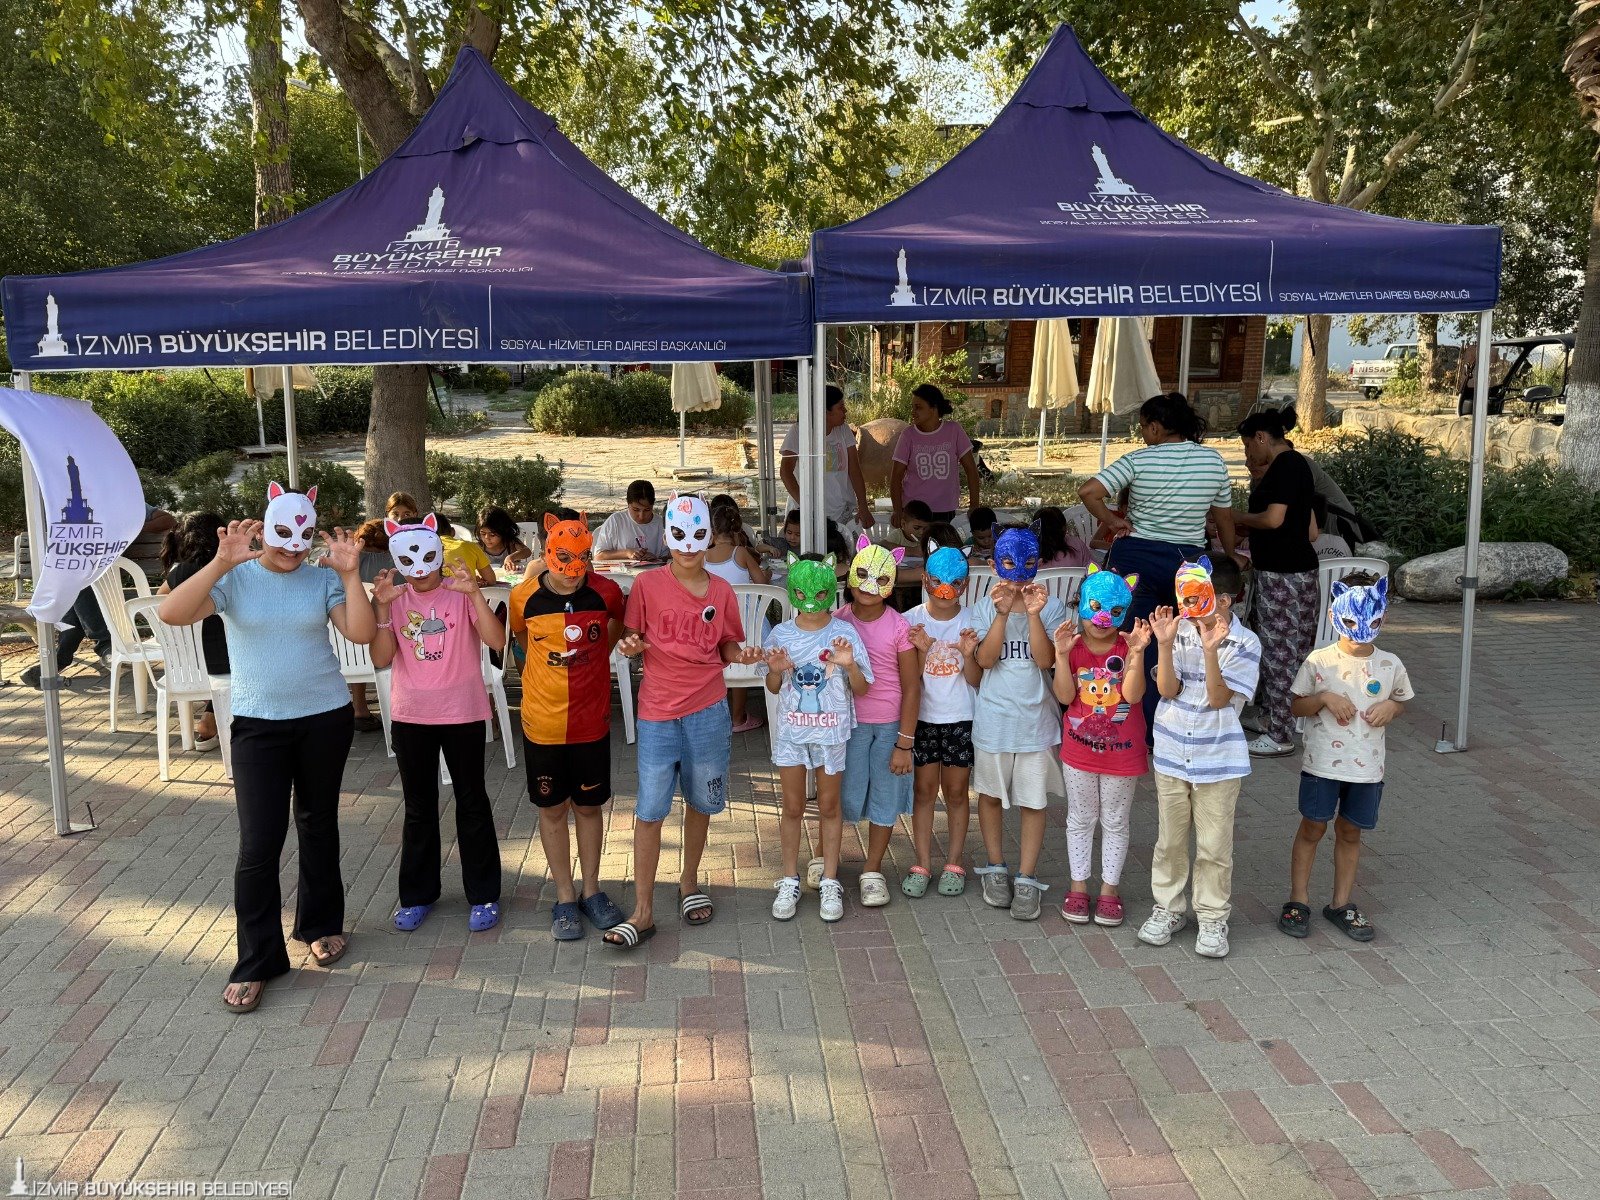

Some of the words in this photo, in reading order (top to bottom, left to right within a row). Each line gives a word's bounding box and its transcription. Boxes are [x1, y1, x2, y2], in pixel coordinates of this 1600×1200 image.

[923, 285, 986, 307] İZMİR
[993, 283, 1134, 307] BÜYÜKŞEHİR
[1140, 281, 1261, 303] BELEDİYESİ
[1279, 291, 1318, 302] SOSYAL
[1319, 290, 1374, 301] HİZMETLER
[1374, 289, 1412, 301] DAİRESİ
[1413, 289, 1471, 301] BAŞKANLIĞI
[75, 332, 153, 356] İZMİR
[160, 329, 327, 355] BÜYÜKŞEHİR
[334, 326, 480, 352] BELEDİYESİ
[500, 338, 546, 351] SOSYAL
[549, 338, 612, 352] HİZMETLER
[615, 338, 659, 352] DAİRESİ
[660, 338, 727, 352] BAŞKANLIĞI
[916, 450, 951, 480] 89
[49, 525, 104, 540] İZMİR
[657, 608, 718, 655] GAP
[787, 711, 839, 727] STITCH
